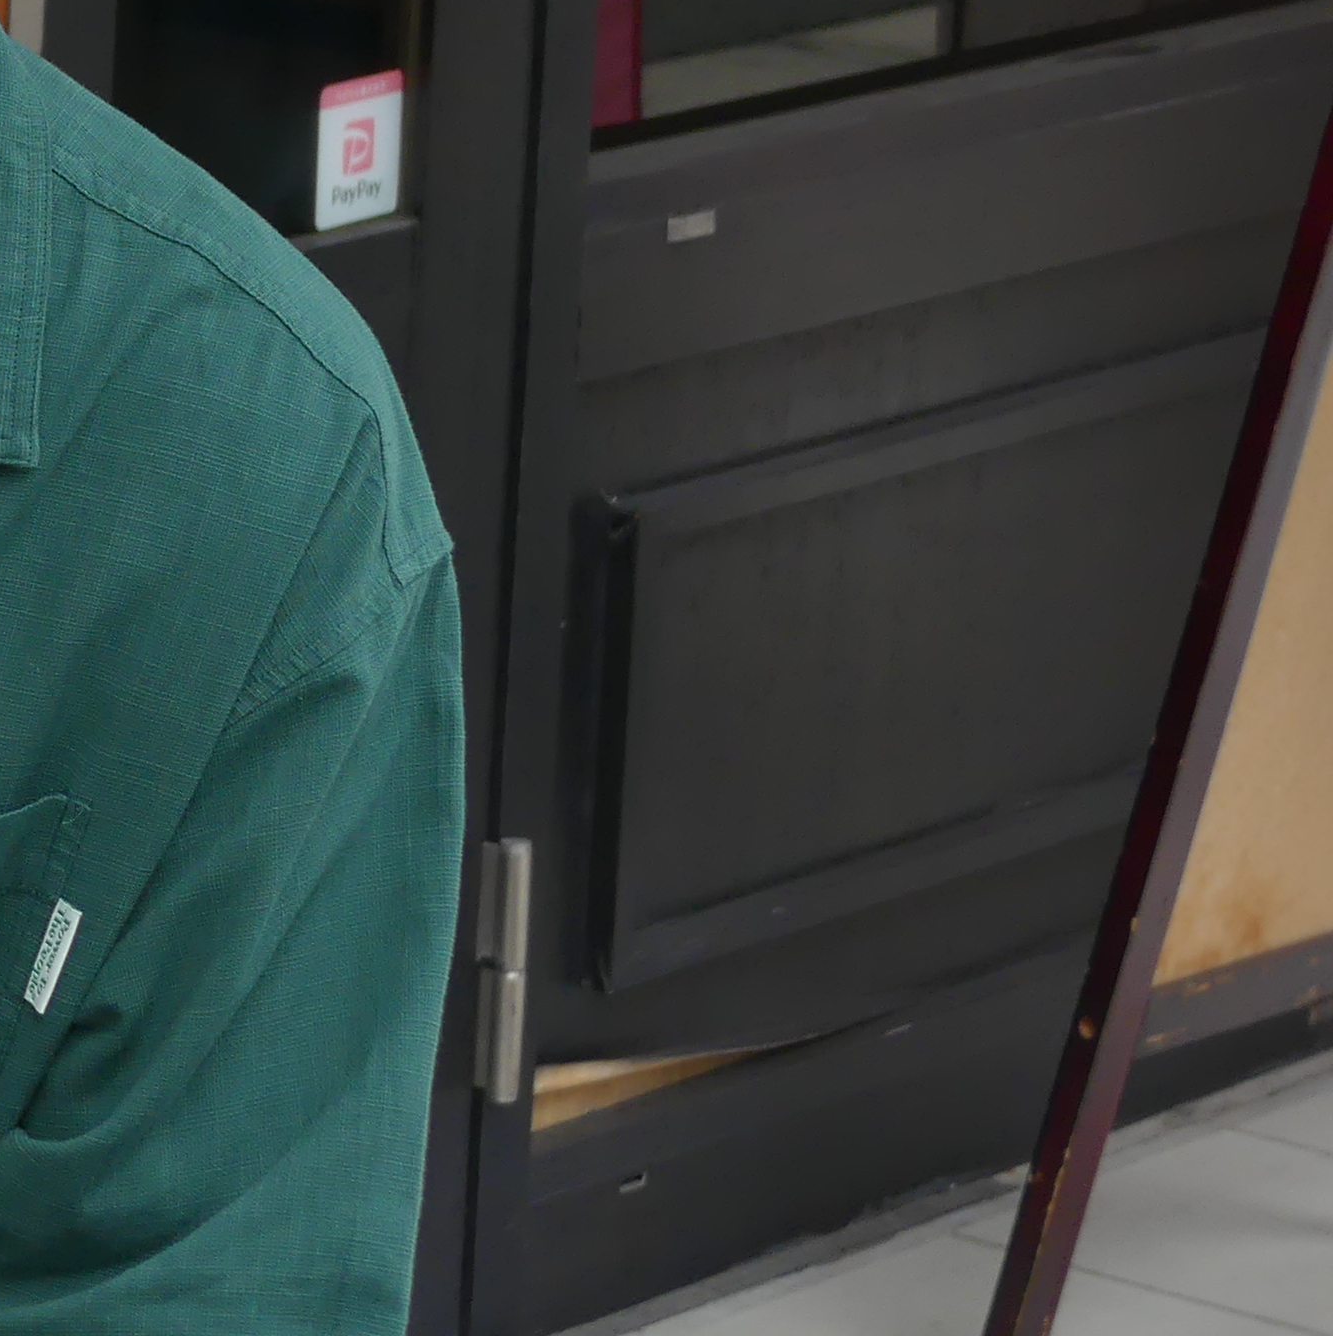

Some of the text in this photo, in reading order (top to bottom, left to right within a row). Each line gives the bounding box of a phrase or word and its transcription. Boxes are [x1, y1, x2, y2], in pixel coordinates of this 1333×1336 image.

[331, 178, 382, 205] PayPay
[28, 907, 67, 995] The People
[36, 917, 72, 996] Power To
